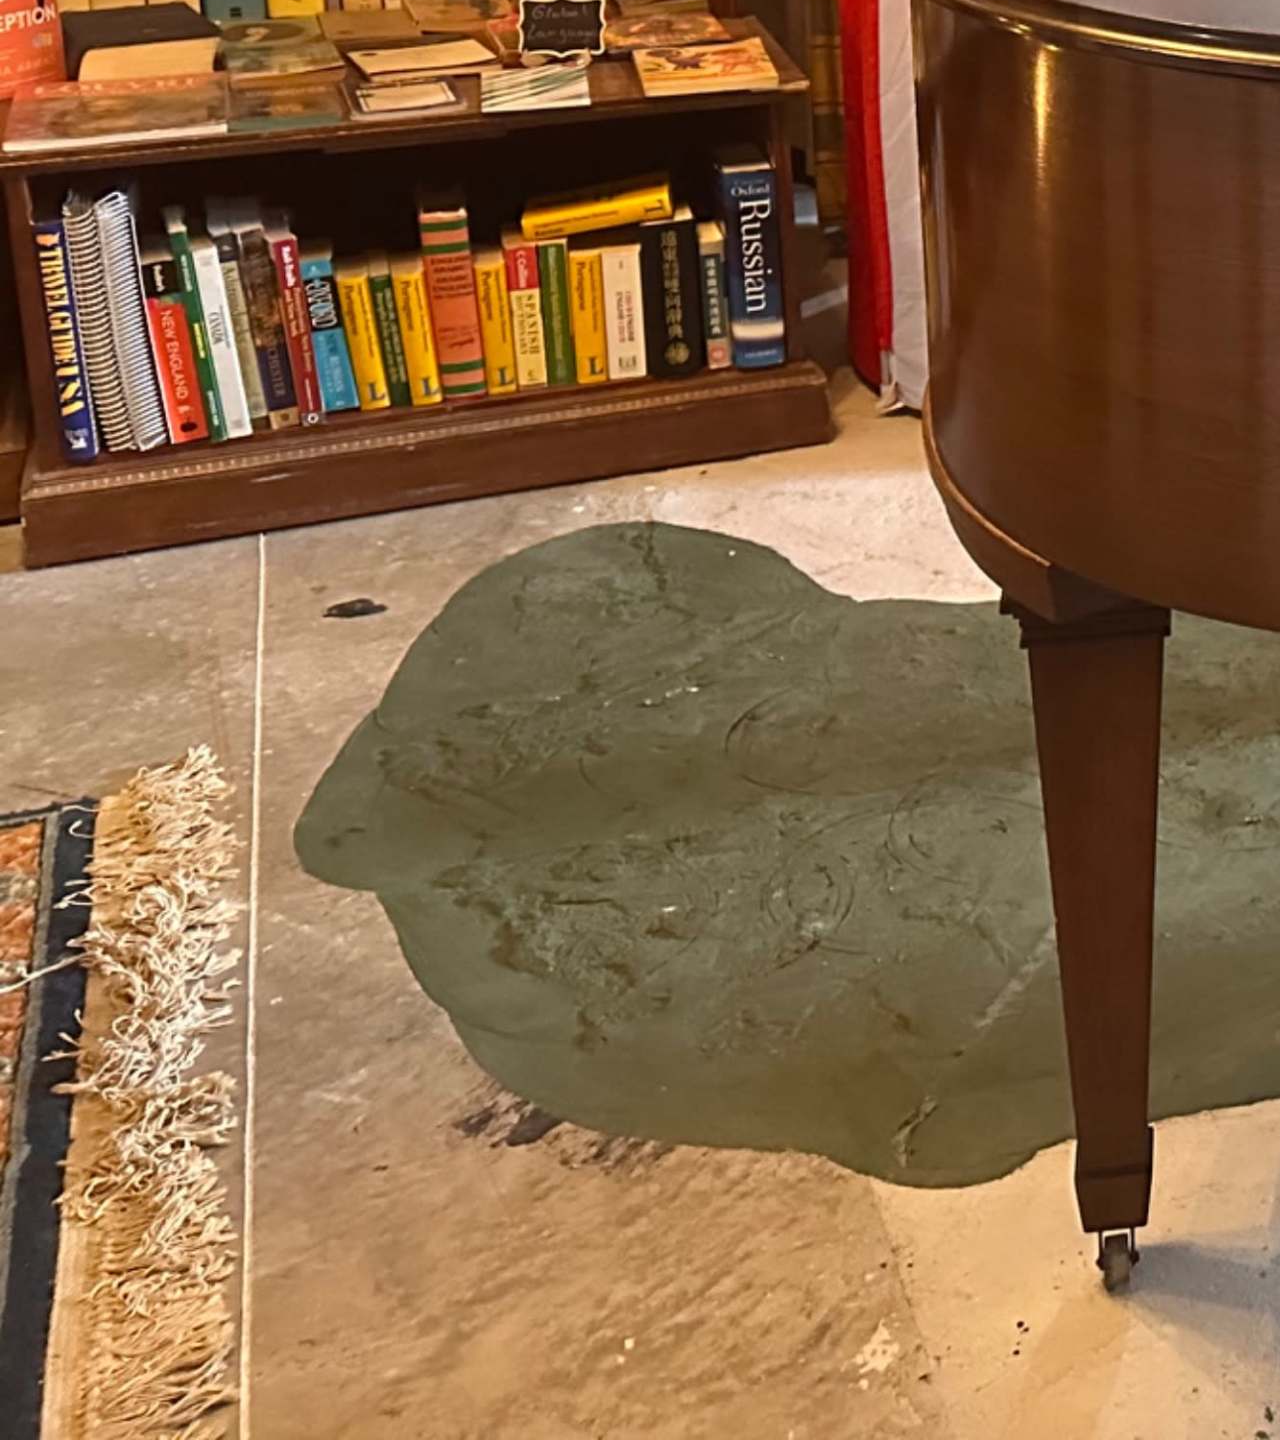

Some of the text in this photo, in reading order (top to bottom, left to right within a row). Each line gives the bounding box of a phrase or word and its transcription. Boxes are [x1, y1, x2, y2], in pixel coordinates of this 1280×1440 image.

[730, 183, 770, 197] Oxford
[39, 247, 71, 311] TRAVEL
[739, 197, 773, 314] Russian
[160, 309, 178, 338] NEW
[480, 270, 494, 322] Portuguese
[525, 293, 541, 355] SPANISH
[48, 311, 79, 366] GUIDE
[167, 340, 188, 401] ENGLAND
